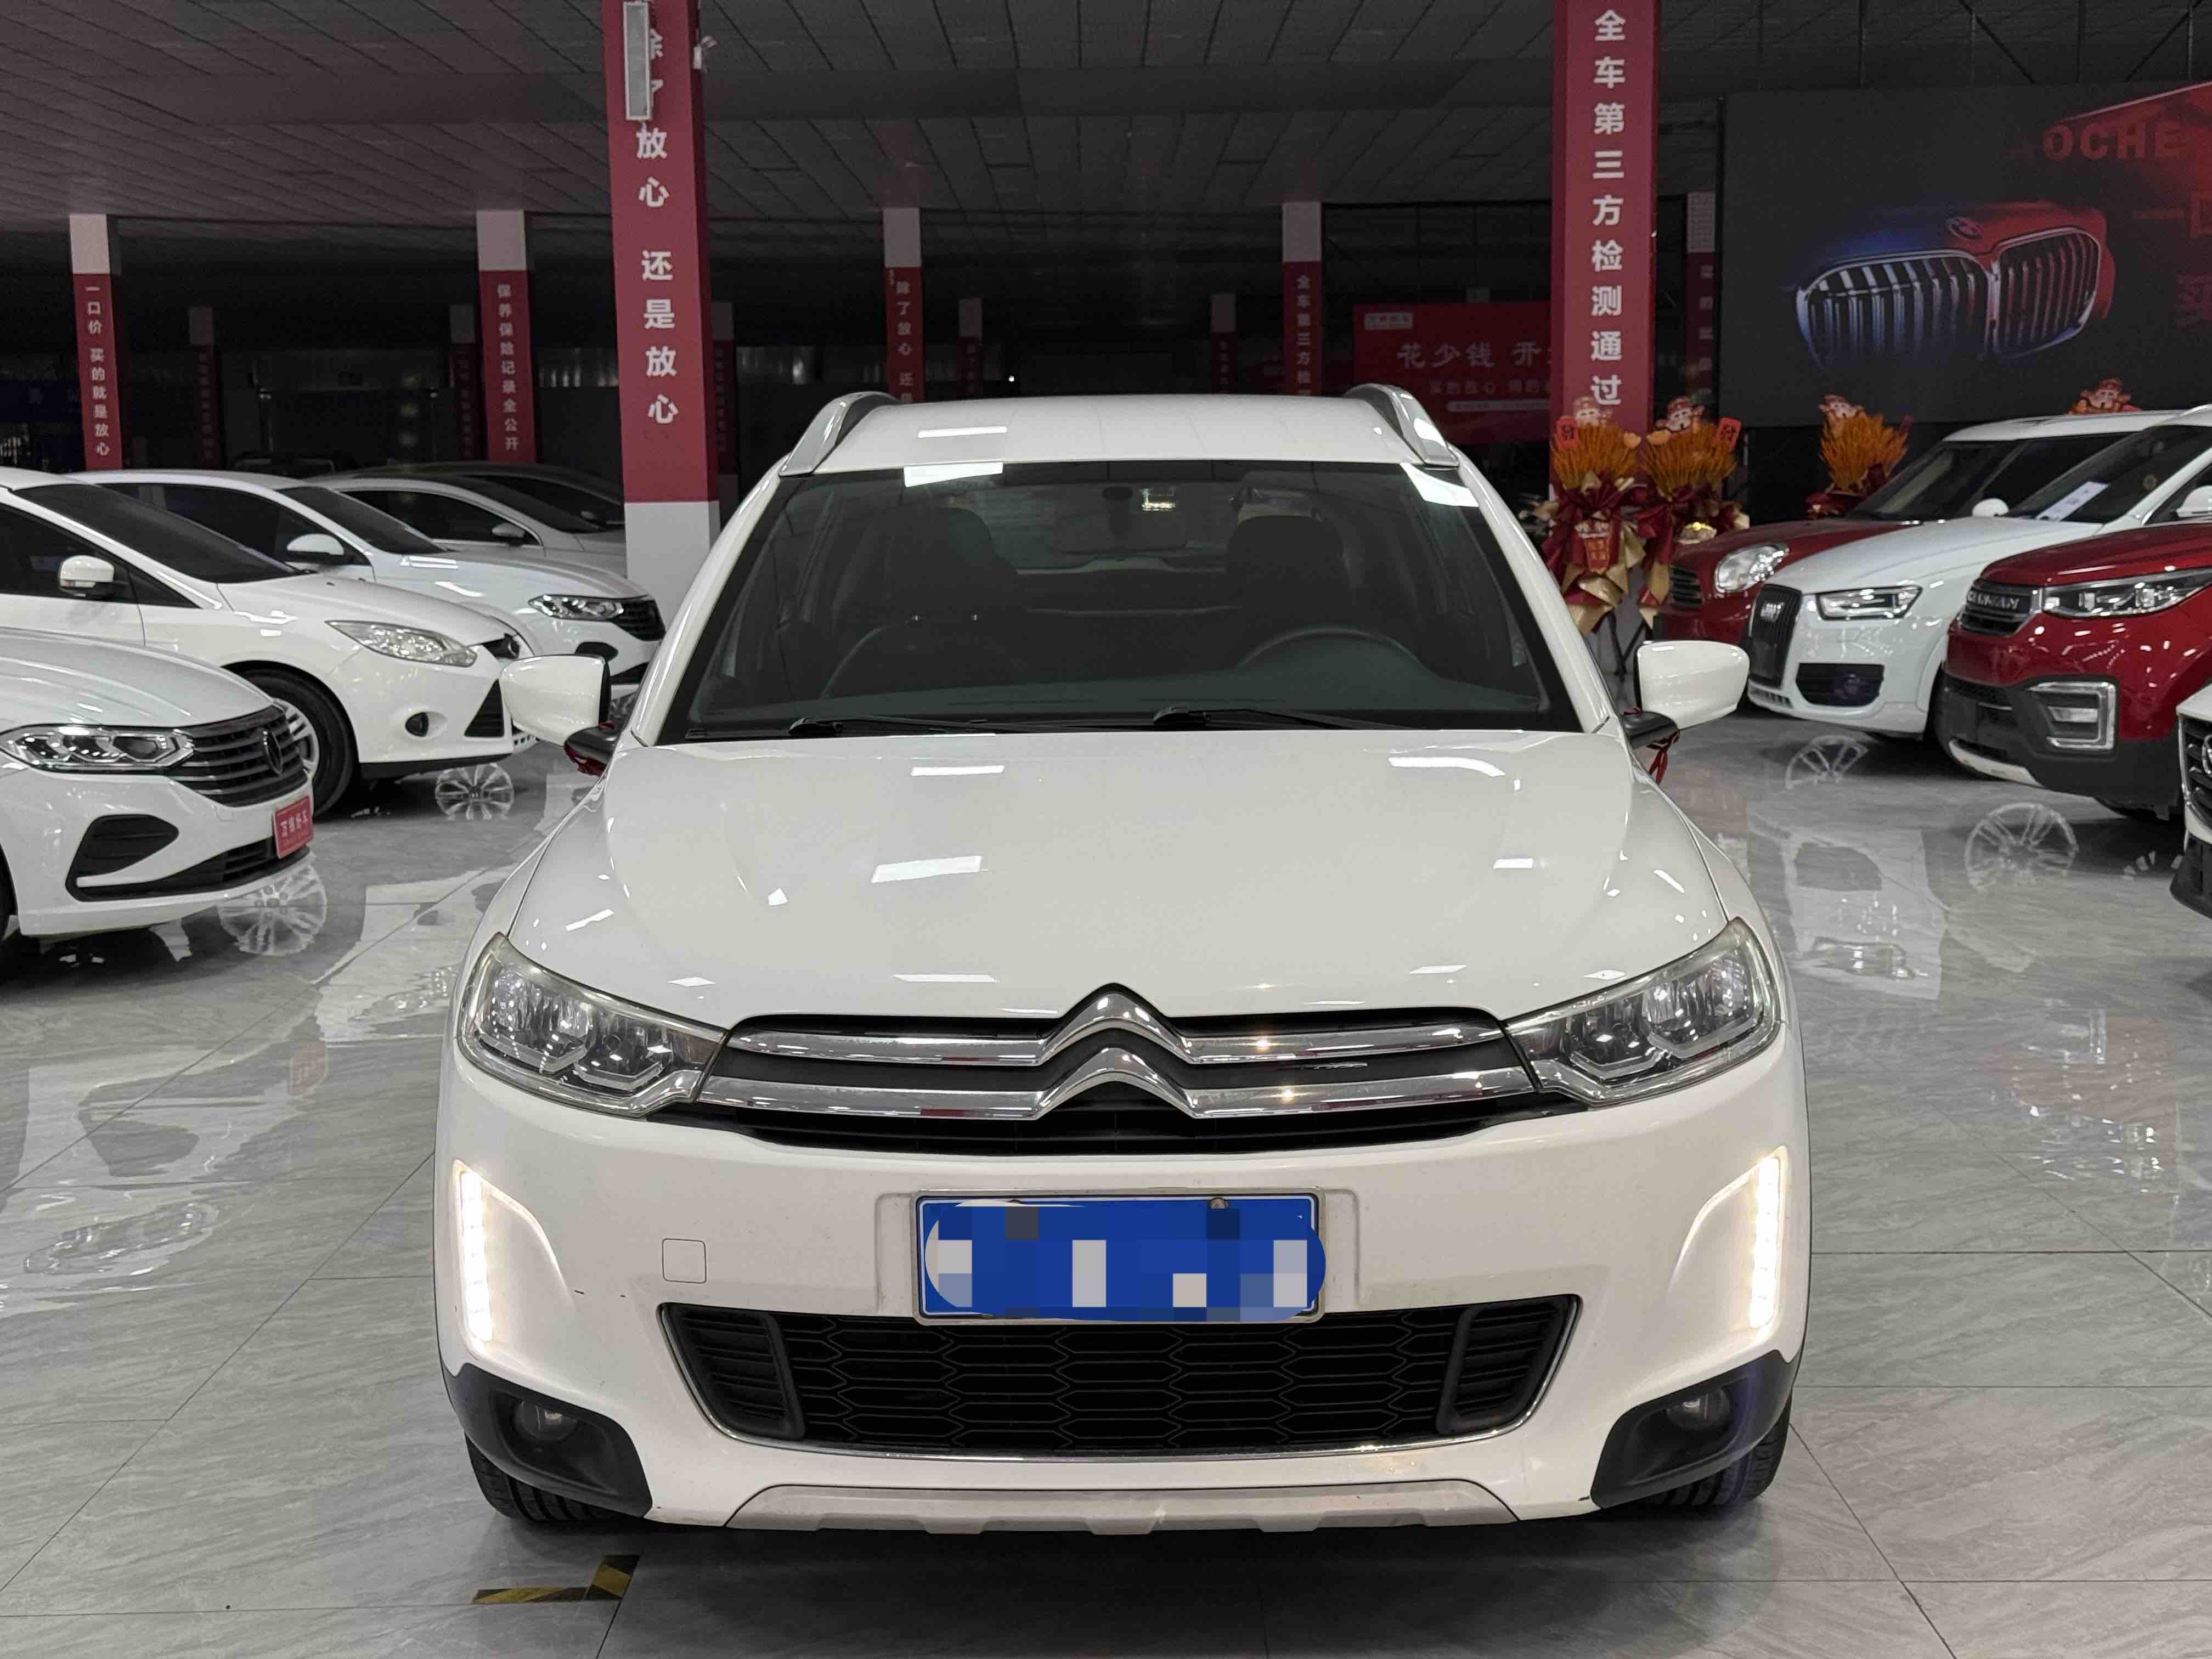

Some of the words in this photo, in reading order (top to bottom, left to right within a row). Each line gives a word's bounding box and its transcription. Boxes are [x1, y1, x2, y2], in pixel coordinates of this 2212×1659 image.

[641, 251, 679, 425] 还是放心
[1591, 9, 1627, 405] 全车第三方检测通过
